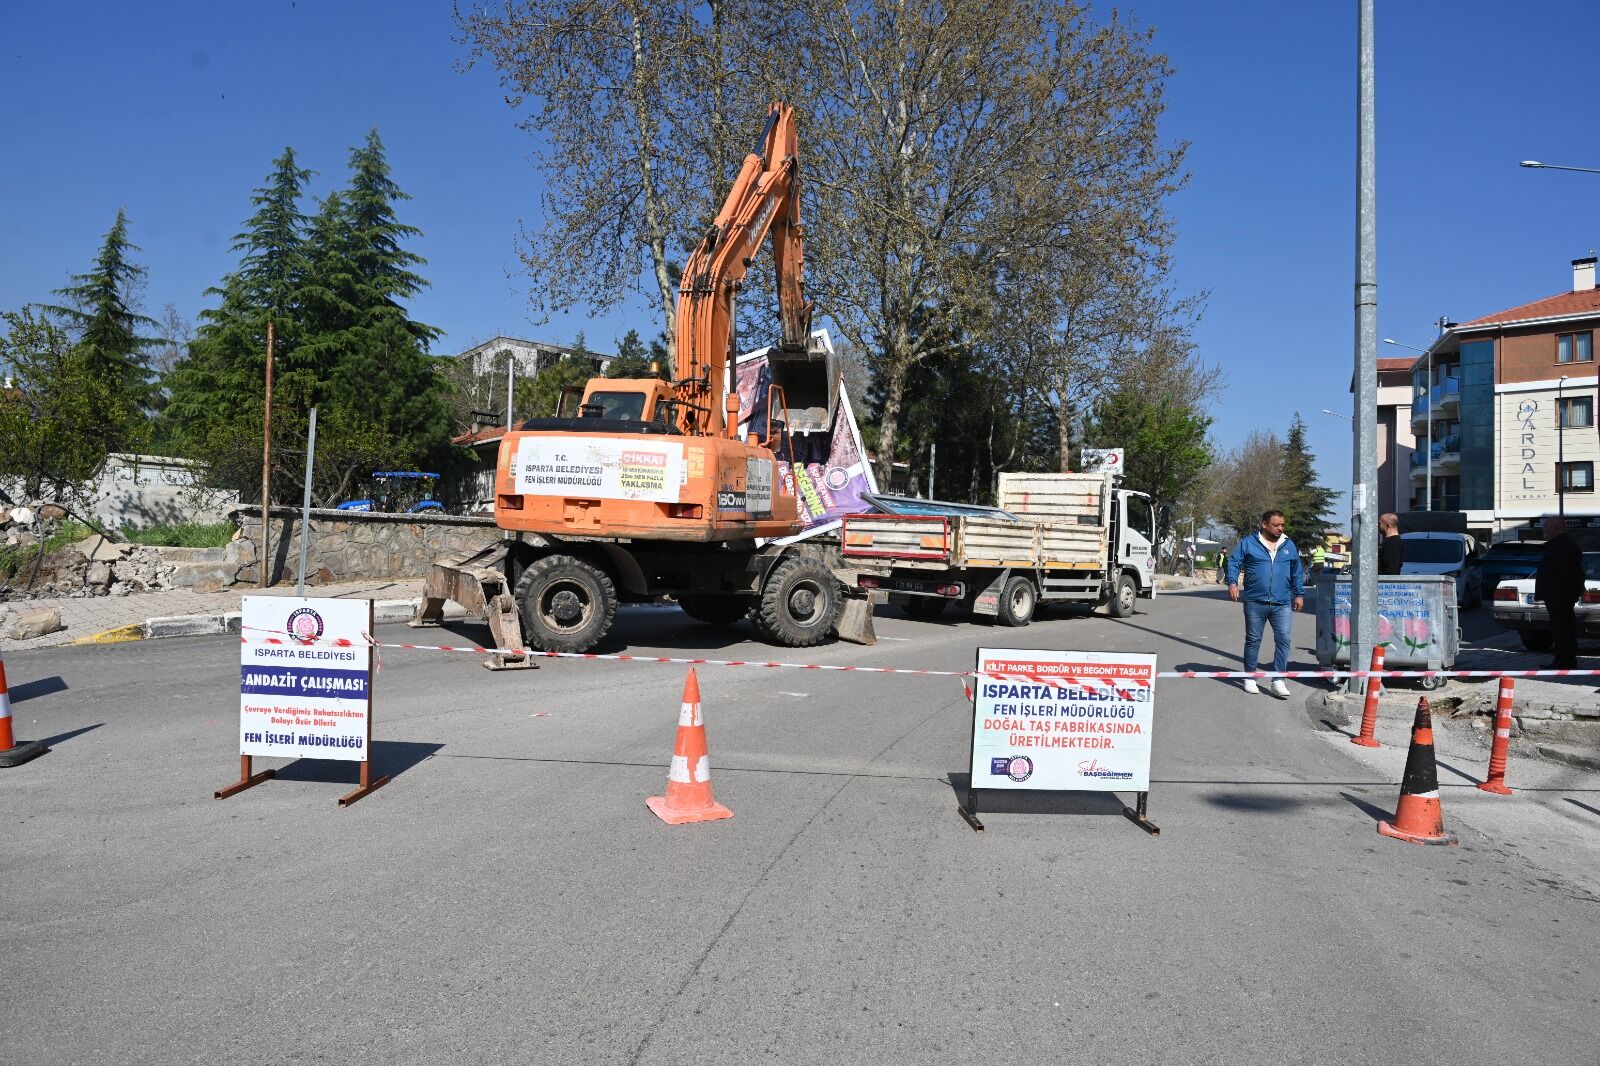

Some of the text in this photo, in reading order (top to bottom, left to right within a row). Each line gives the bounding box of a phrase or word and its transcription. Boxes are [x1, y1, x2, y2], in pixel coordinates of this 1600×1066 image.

[555, 454, 568, 462] T.C.
[525, 464, 554, 473] ISPARTA
[555, 465, 603, 475] BELEDİYESİ
[525, 475, 602, 486] FEN İŞLERİ MÜDÜRLÜĞÜ
[254, 648, 356, 662] ISPARTA BELEDİYESİ
[986, 661, 1006, 671] KİLİT
[1036, 664, 1070, 674] BORDÜR
[1071, 666, 1082, 674] VE
[1083, 665, 1117, 675] BEGONİT
[1119, 667, 1149, 676] TAŞLAR
[245, 672, 364, 693] ANDAZİT ÇALIŞMASI
[983, 684, 1053, 700] ISPARTA
[244, 705, 364, 718] Çevreye Verdiğimiz Rahatsızlıktan
[993, 702, 1135, 719] FEN İŞLERİ MÜDÜRLÜĞÜ
[271, 717, 337, 727] Dolayı Özür Dileriz
[983, 717, 1141, 734] DOĞAL TAŞ FABRİKASINDA
[244, 731, 363, 749] FEN İŞLERİ MÜDÜRLÜĞÜ
[1009, 733, 1115, 749] ÜRETİLMEKTEDİR.
